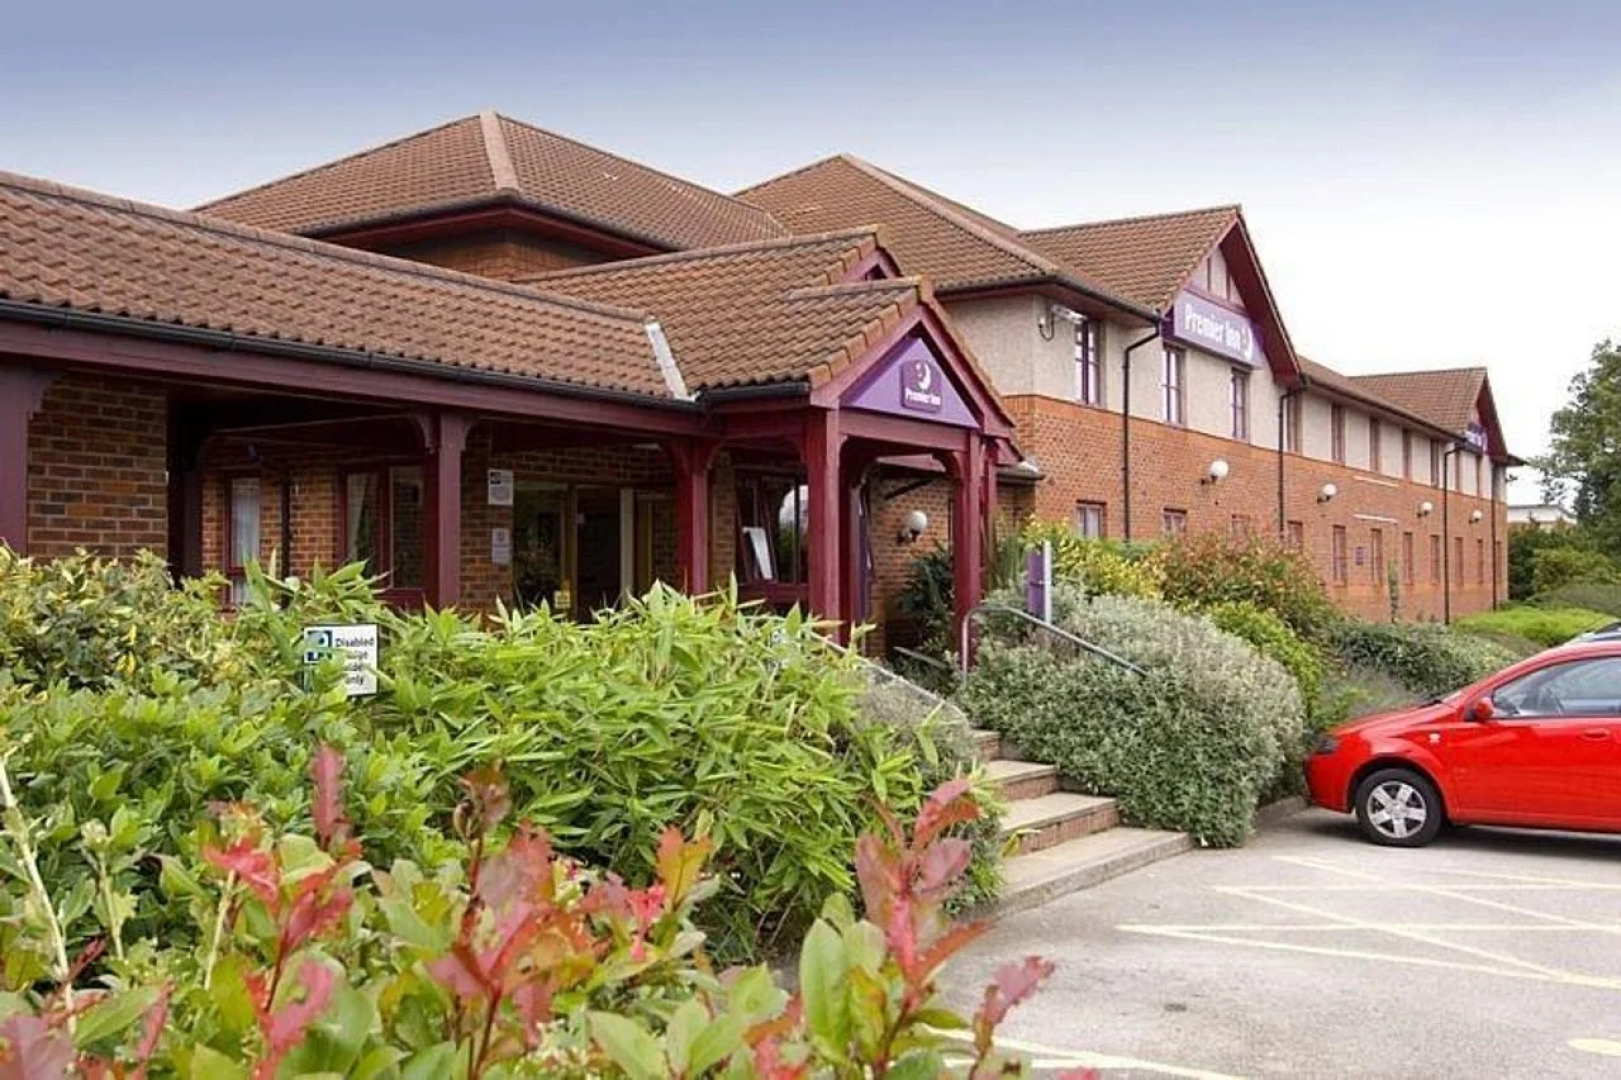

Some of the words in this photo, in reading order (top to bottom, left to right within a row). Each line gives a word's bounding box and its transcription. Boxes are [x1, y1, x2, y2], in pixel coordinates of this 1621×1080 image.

[1185, 303, 1224, 343] Premier
[1225, 321, 1241, 352] Inn
[335, 637, 375, 648] Disabled
